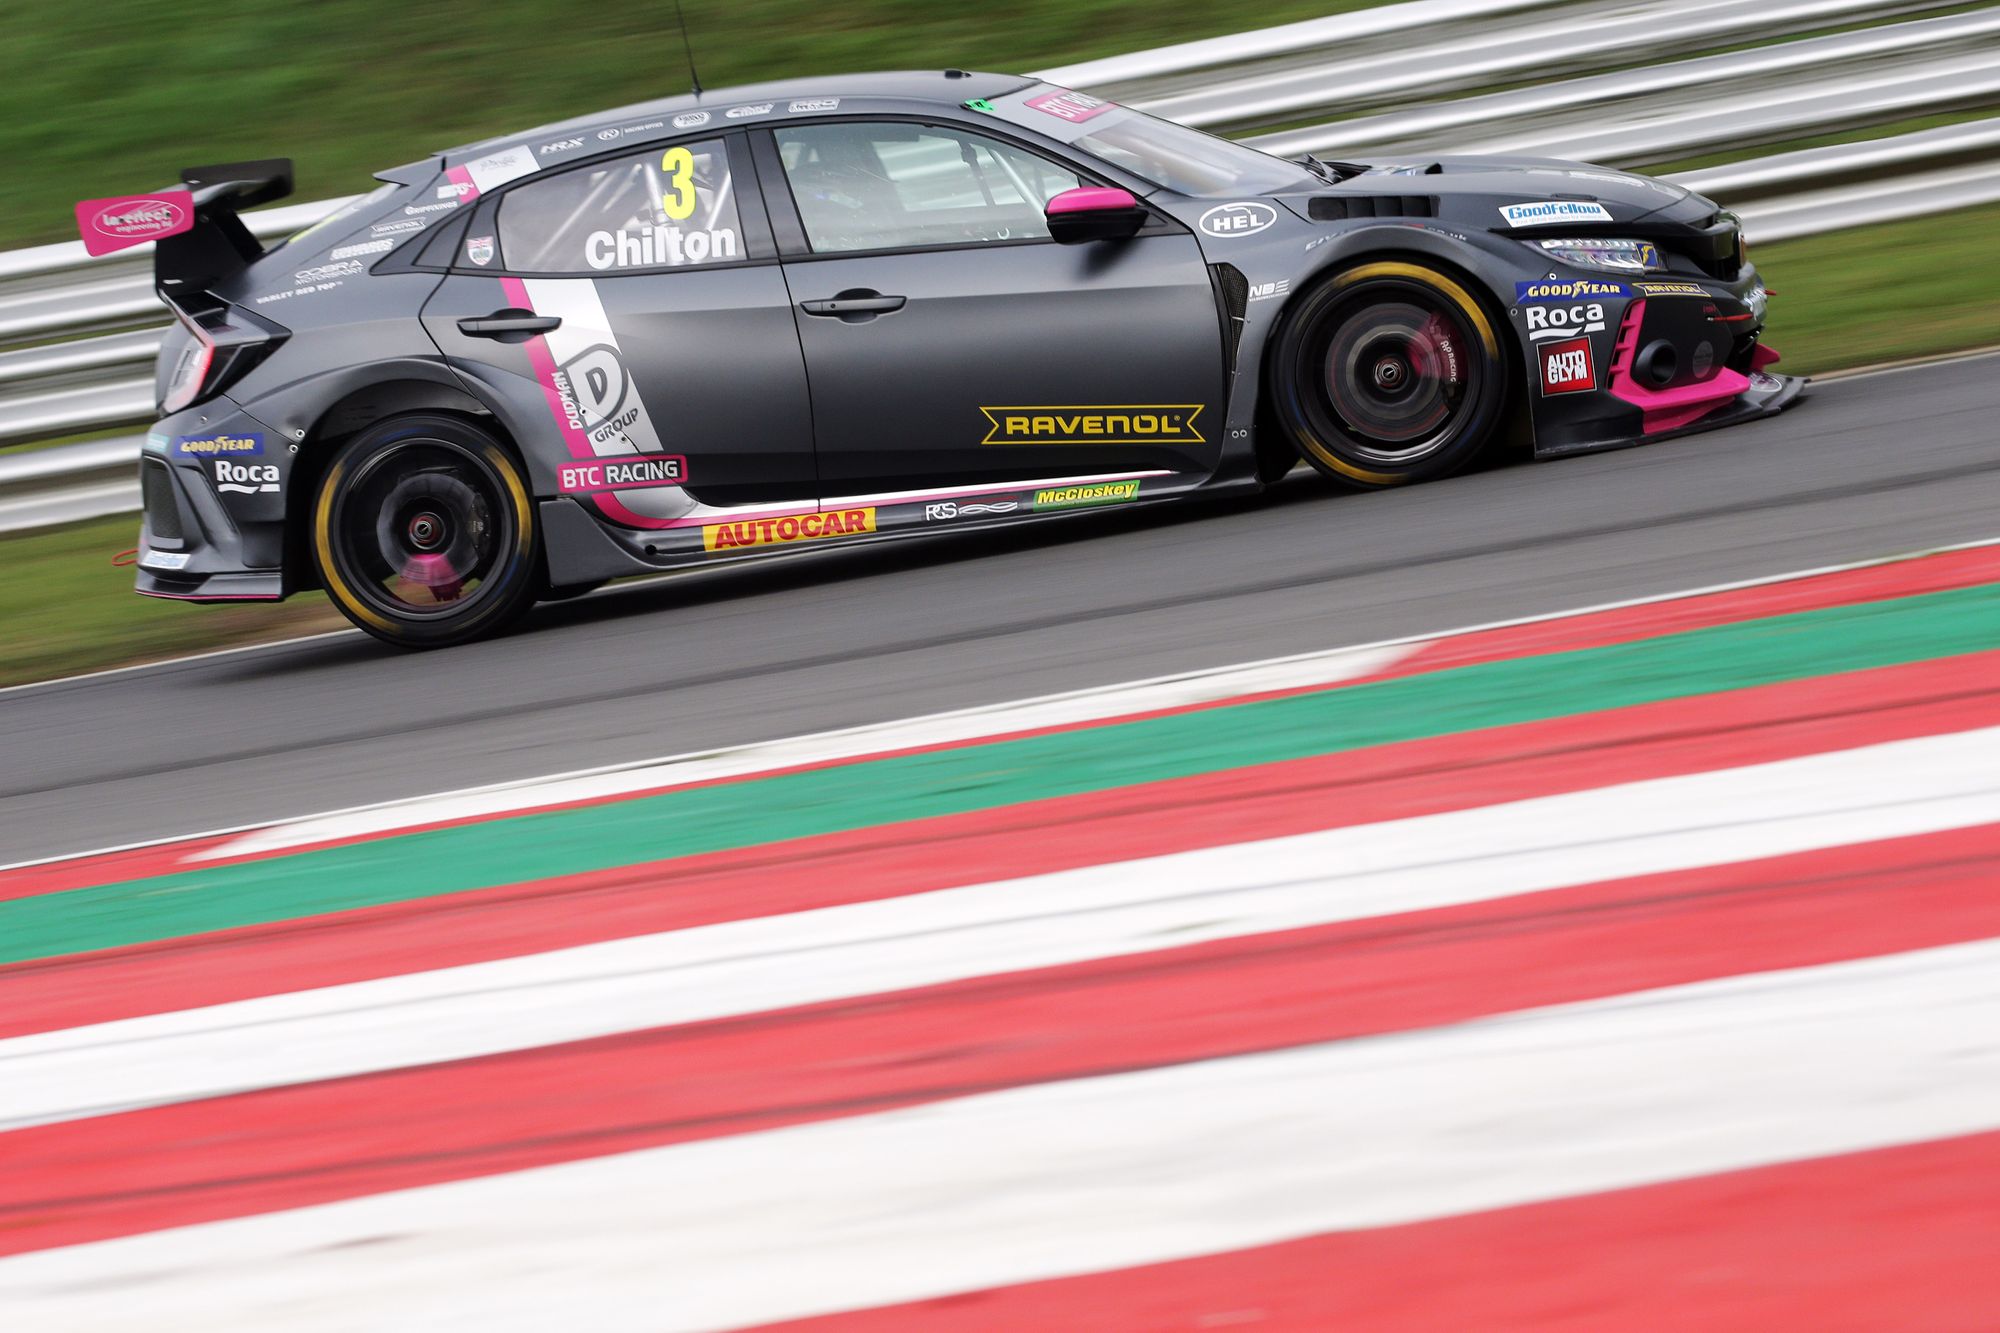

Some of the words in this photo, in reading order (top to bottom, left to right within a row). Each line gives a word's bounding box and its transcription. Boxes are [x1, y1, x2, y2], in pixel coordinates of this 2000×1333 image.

[661, 146, 697, 221] 3
[1212, 213, 1265, 232] HEL
[1508, 203, 1602, 219] Goodfellow
[584, 226, 738, 270] Chilton
[294, 259, 364, 278] COBRA
[256, 290, 294, 304] VARLEY
[1525, 303, 1604, 330] Roca
[1547, 350, 1586, 371] AUTO
[1547, 364, 1588, 384] GLYM
[551, 370, 583, 430] DUDMAN
[594, 407, 640, 443] GROUP
[214, 459, 281, 483] Roca
[562, 465, 601, 490] BTC
[605, 460, 680, 484] RACING
[1036, 483, 1137, 505] McCloskey
[714, 510, 867, 550] AUTOCAR
